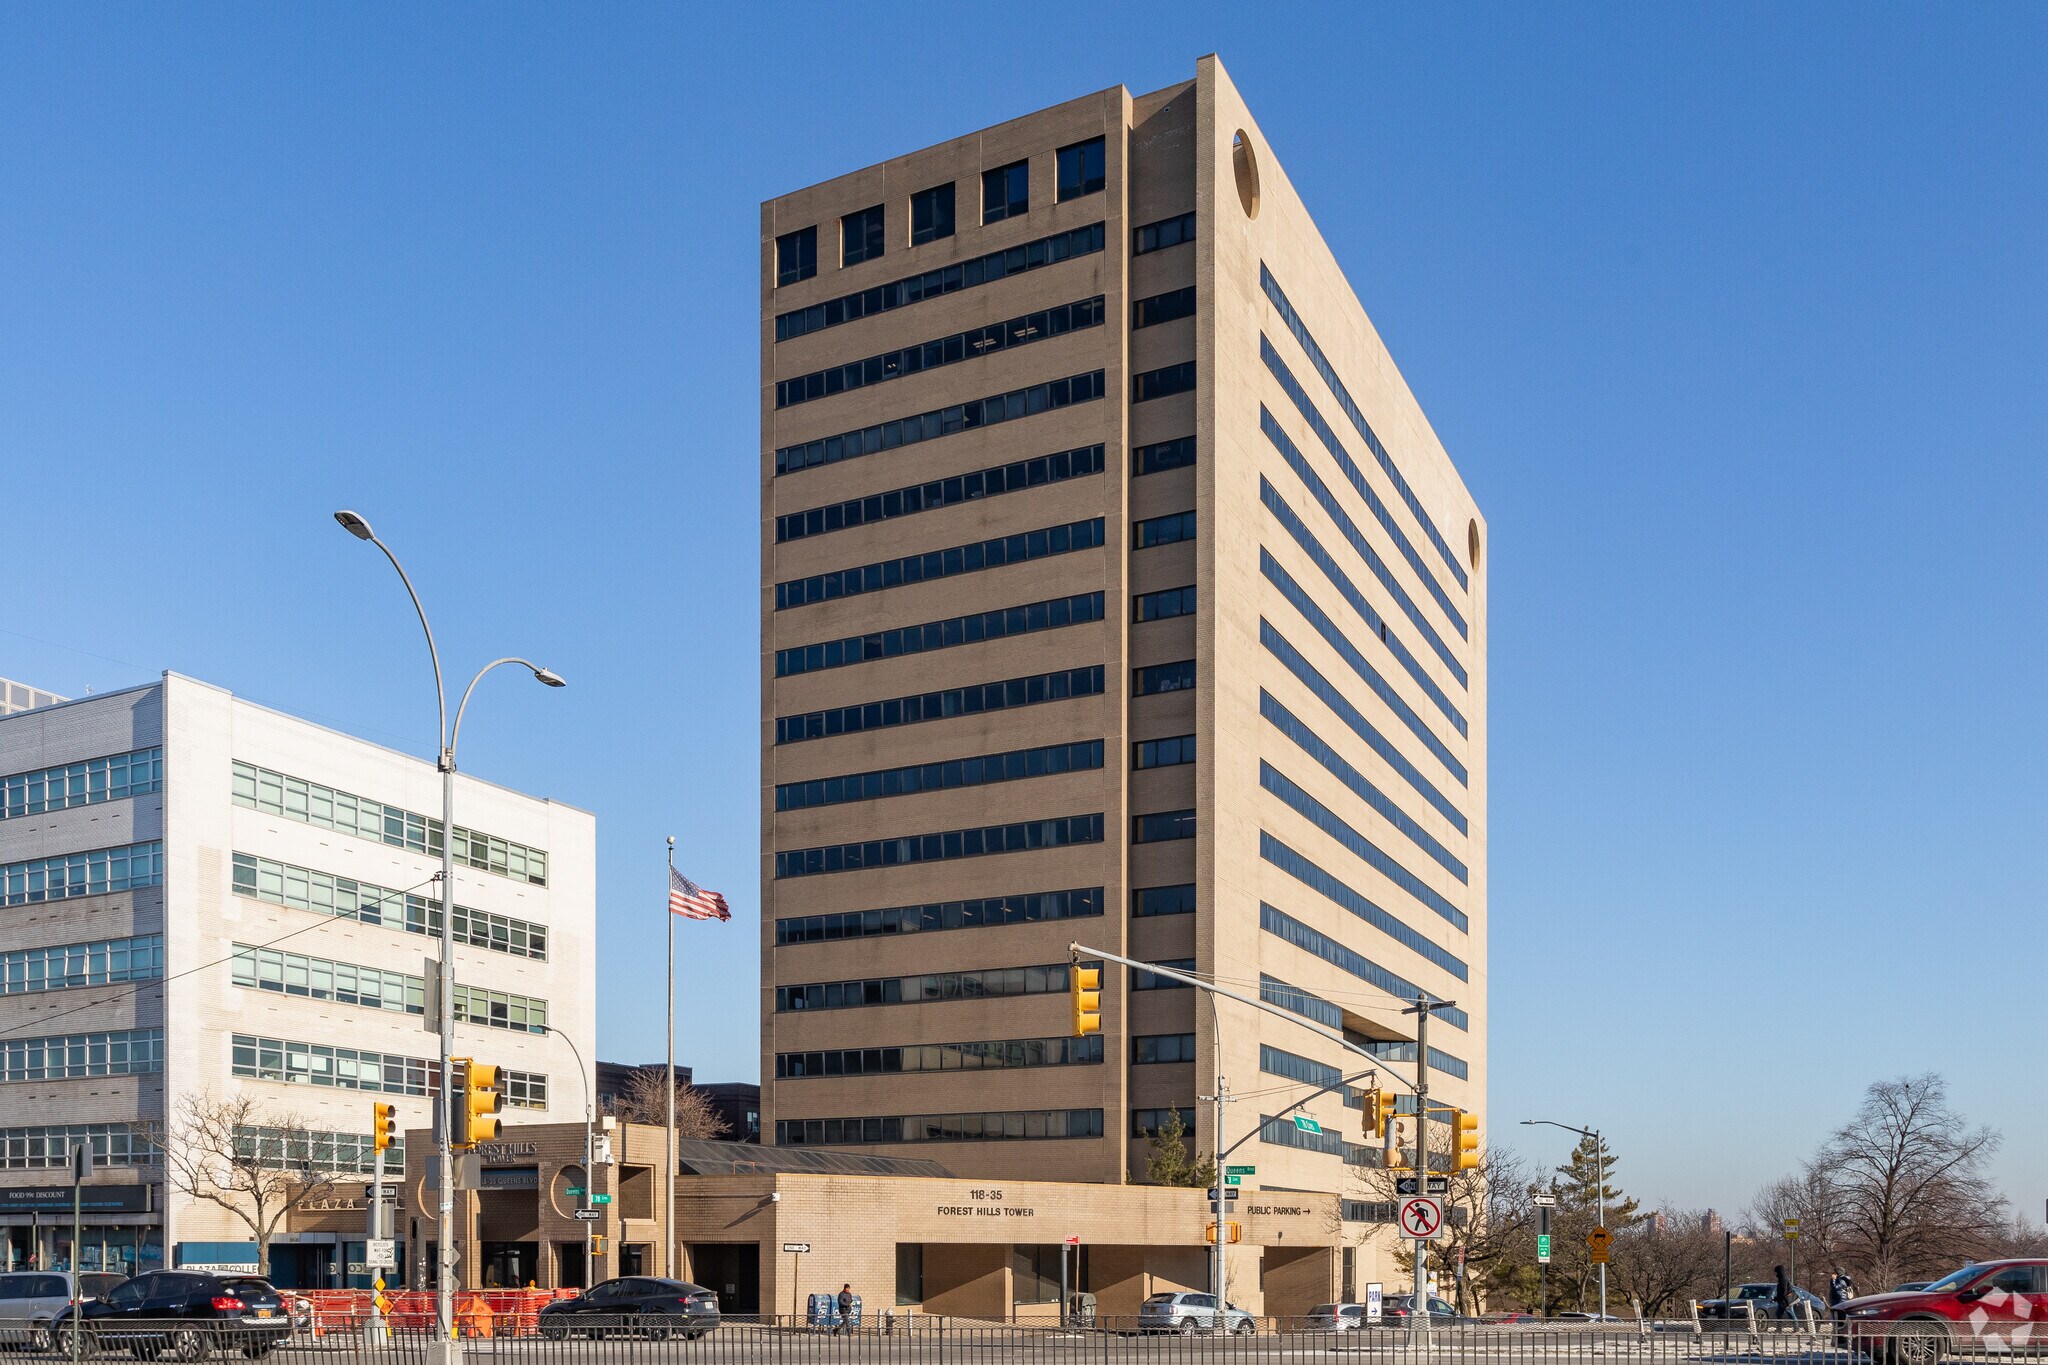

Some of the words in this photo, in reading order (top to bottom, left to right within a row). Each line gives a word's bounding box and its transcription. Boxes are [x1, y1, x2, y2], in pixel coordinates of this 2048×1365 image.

[509, 1142, 538, 1155] HILLS
[489, 1154, 517, 1164] TOWER
[1226, 1166, 1246, 1175] Queens
[498, 1176, 521, 1185] QUEENS
[523, 1176, 538, 1184] BLVD
[1404, 1182, 1417, 1190] ON
[9, 1191, 25, 1199] FOOD
[970, 1189, 1003, 1200] 118-35
[297, 1199, 357, 1211] PLAZA
[937, 1206, 973, 1216] FOREST
[976, 1207, 1001, 1216] HILLS
[1004, 1207, 1034, 1217] TOWER
[1247, 1205, 1271, 1215] PUBLIC
[1273, 1206, 1301, 1216] PARKING
